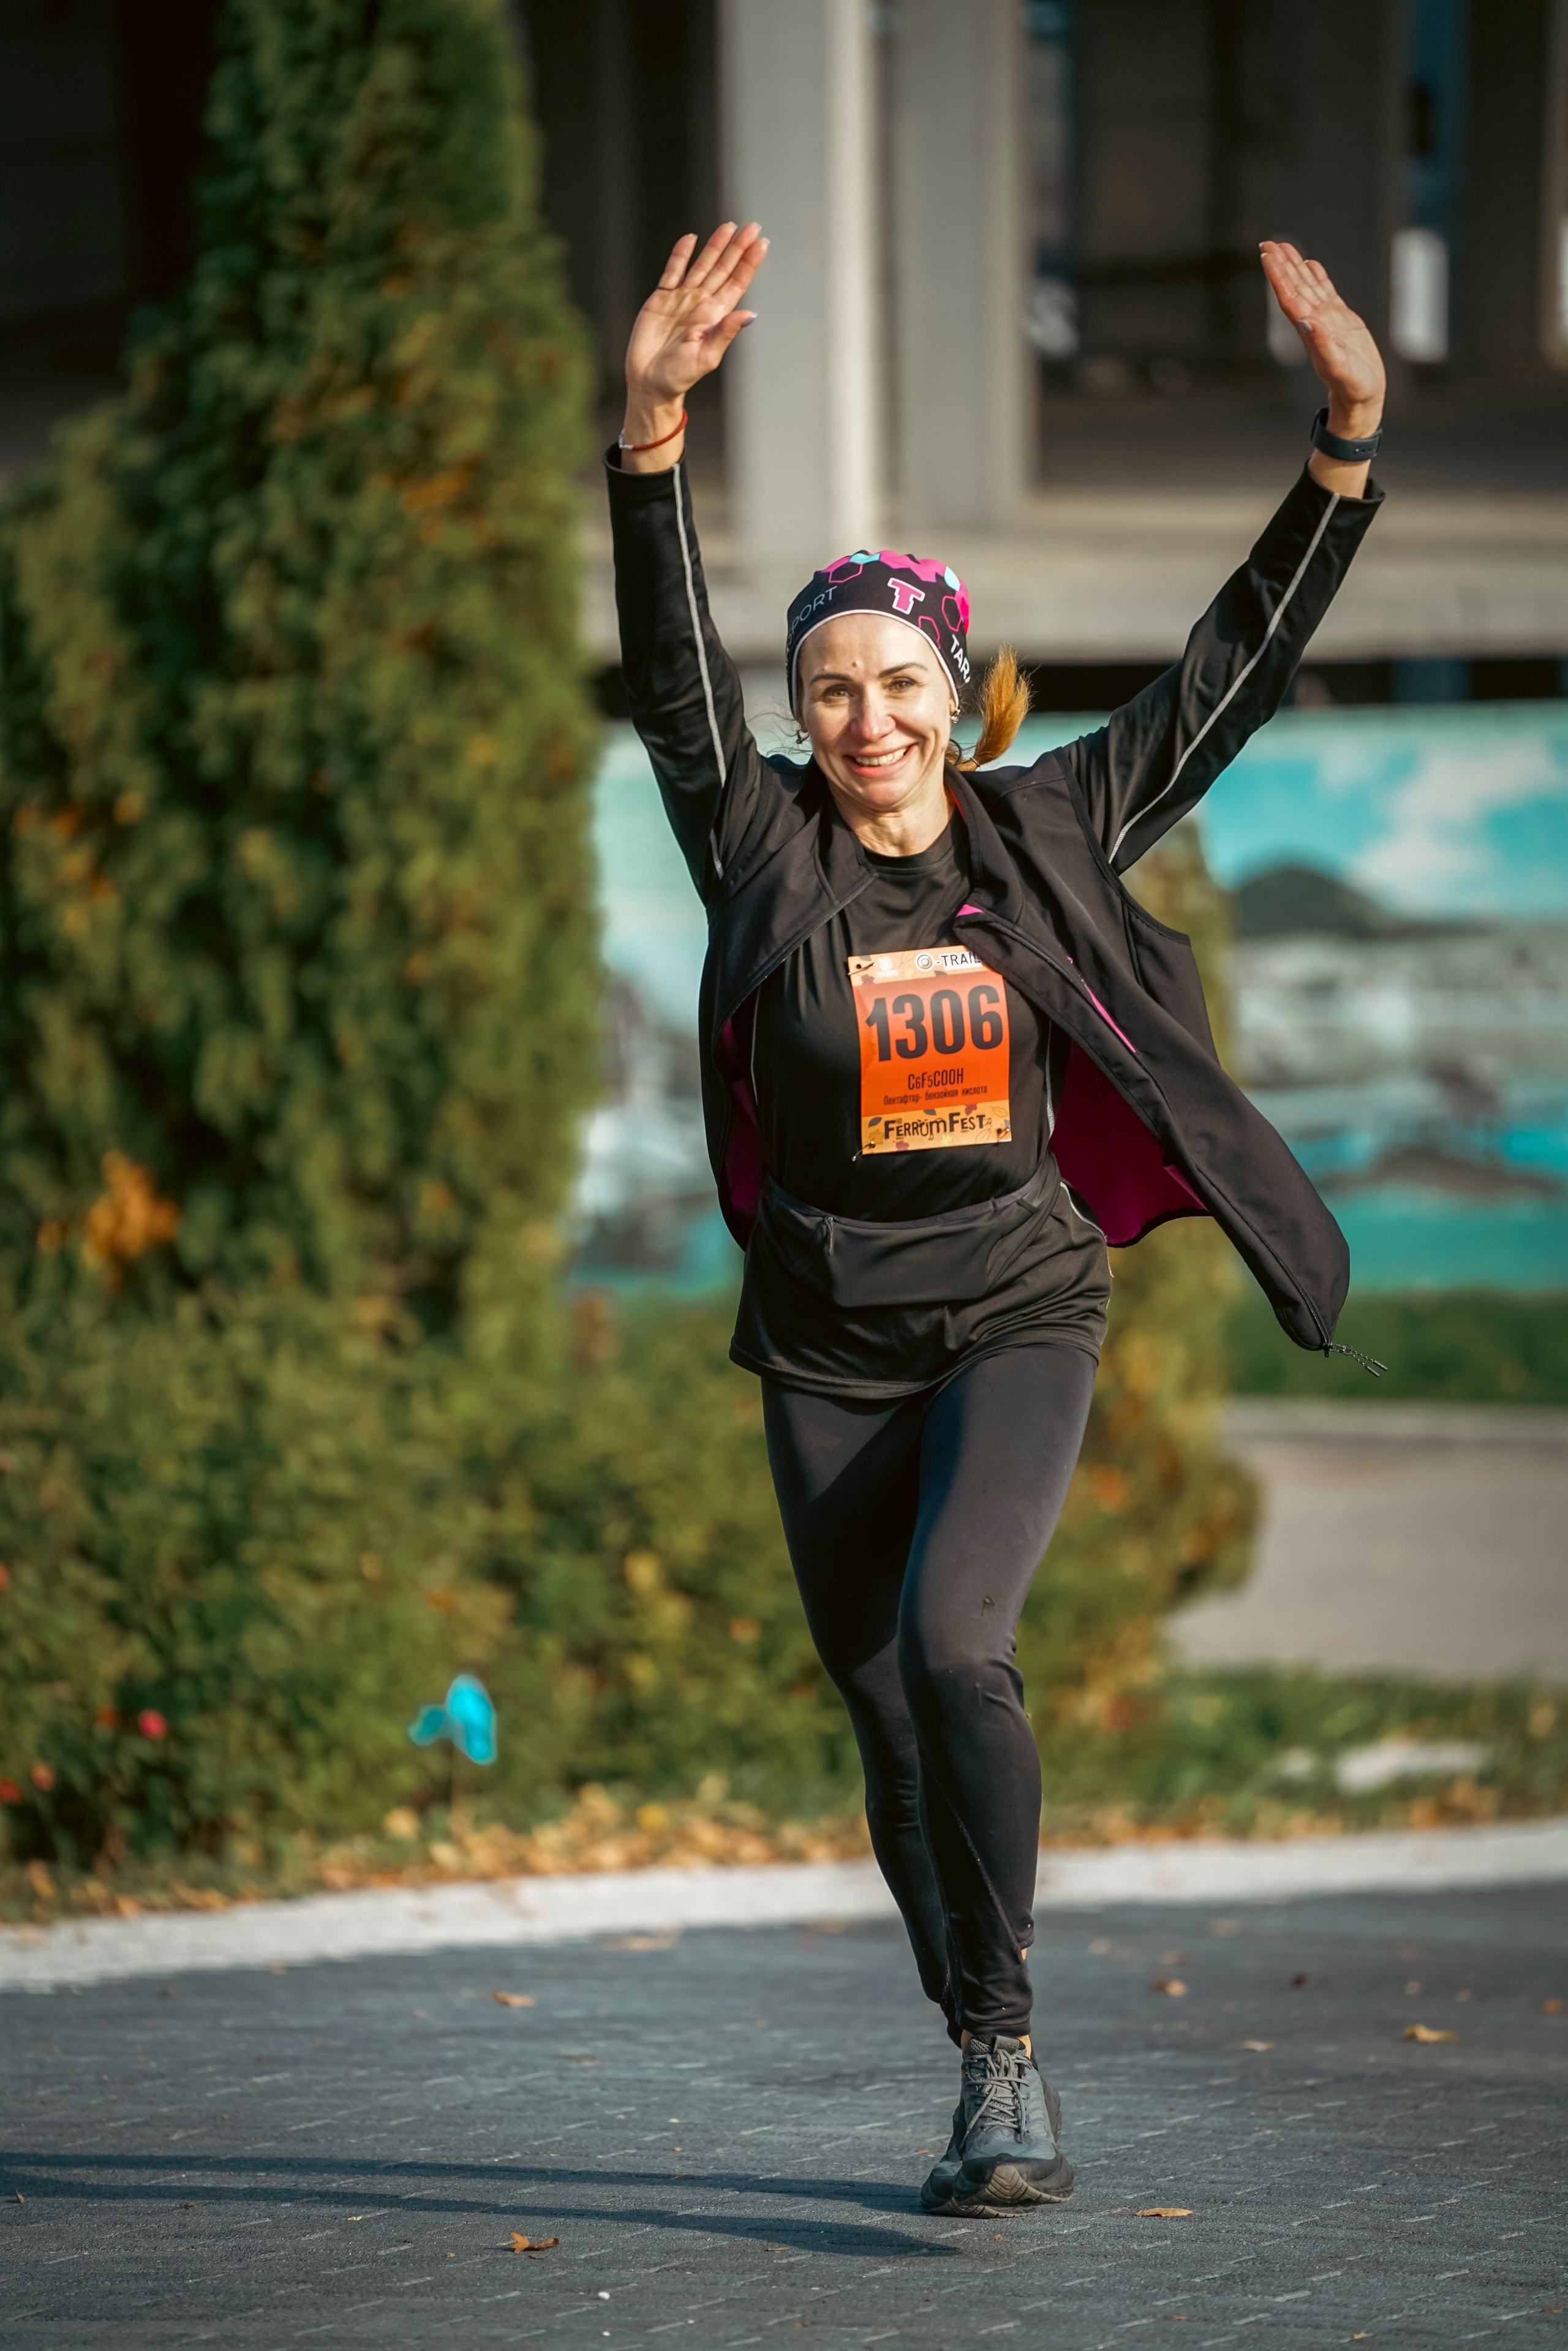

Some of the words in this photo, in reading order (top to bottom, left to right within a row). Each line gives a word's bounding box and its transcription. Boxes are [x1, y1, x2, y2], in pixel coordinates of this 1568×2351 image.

[888, 577, 925, 615] T
[950, 633, 971, 684] TAR
[865, 984, 1003, 1062] 1306
[908, 1068, 964, 1090] C6F5COOH
[925, 1089, 959, 1101] бензойная
[962, 1085, 987, 1096] кислота
